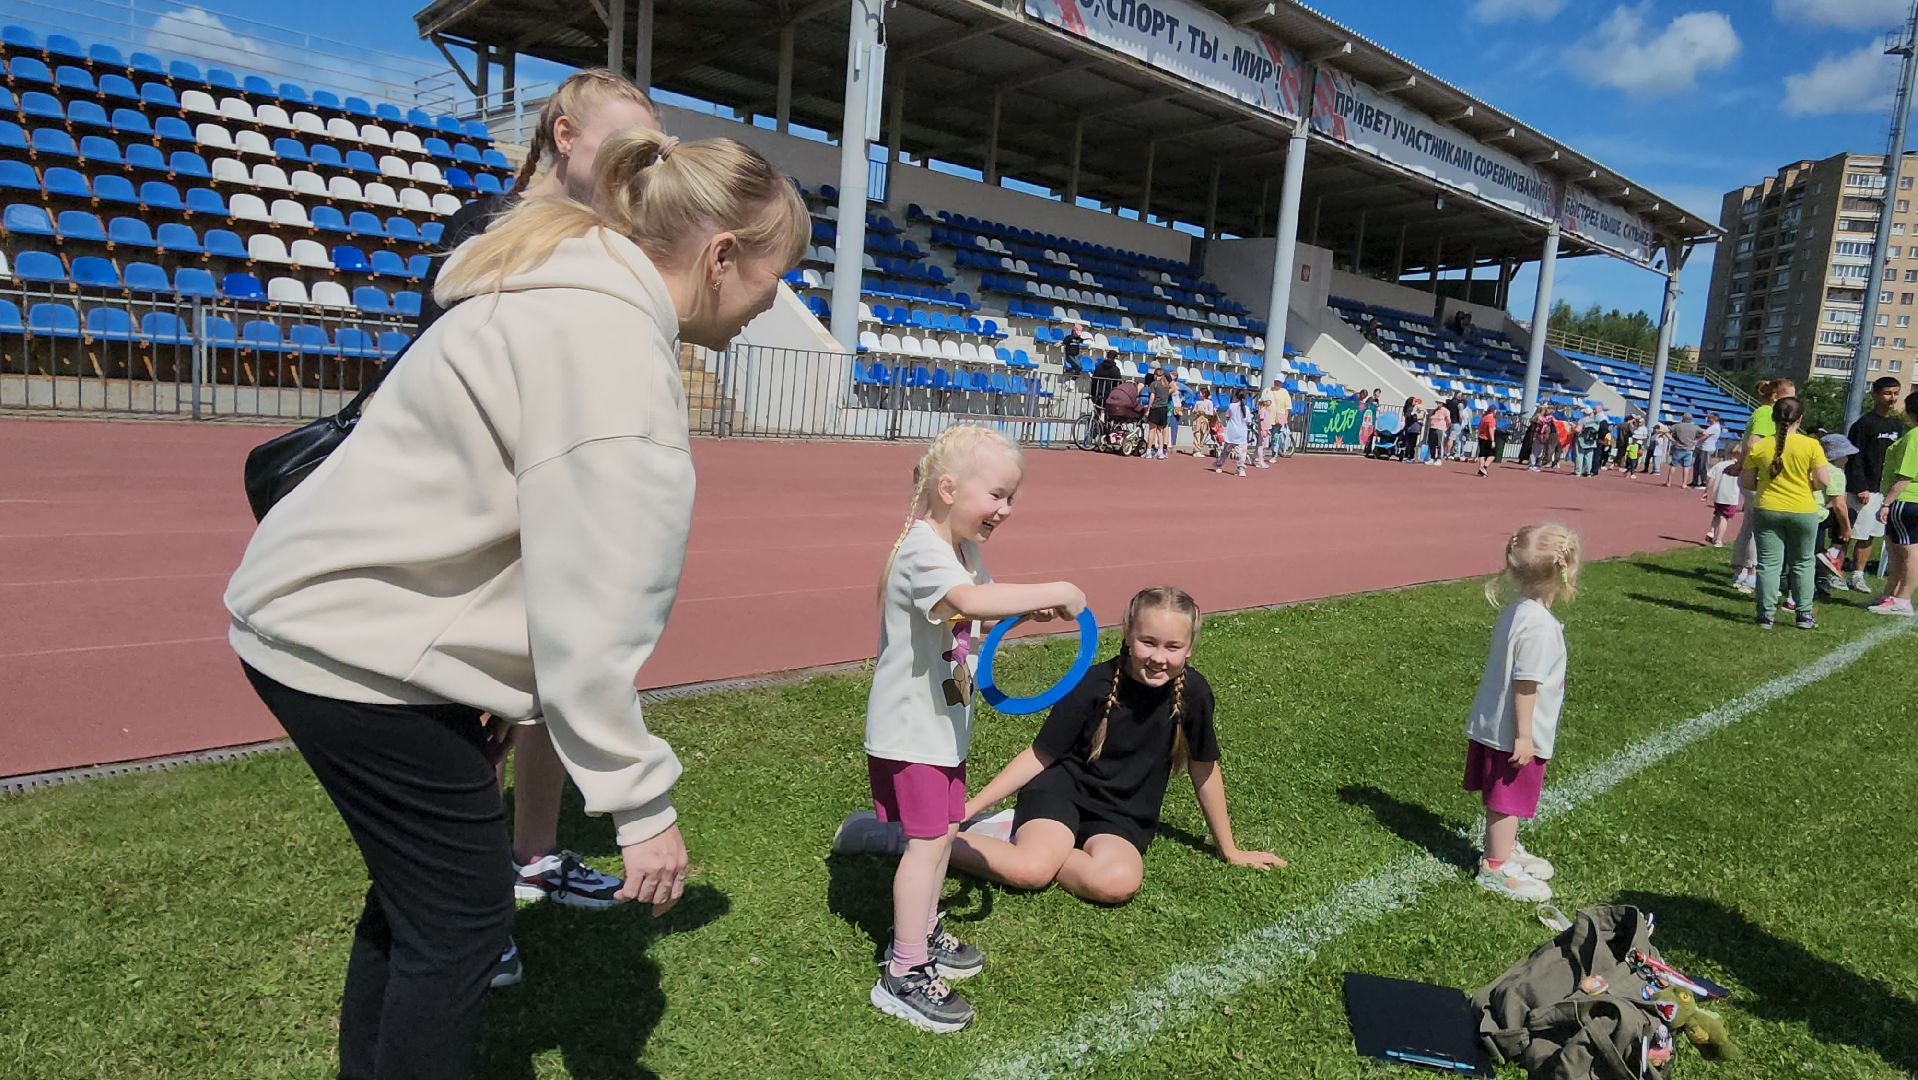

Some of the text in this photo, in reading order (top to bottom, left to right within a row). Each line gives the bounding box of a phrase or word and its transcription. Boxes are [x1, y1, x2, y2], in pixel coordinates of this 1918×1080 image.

[1188, 24, 1219, 63] ТЫ
[1232, 46, 1281, 90] МИР!
[1333, 91, 1391, 136] ПРИВЕТ
[1392, 117, 1473, 171] УЧАСТНИКАМ
